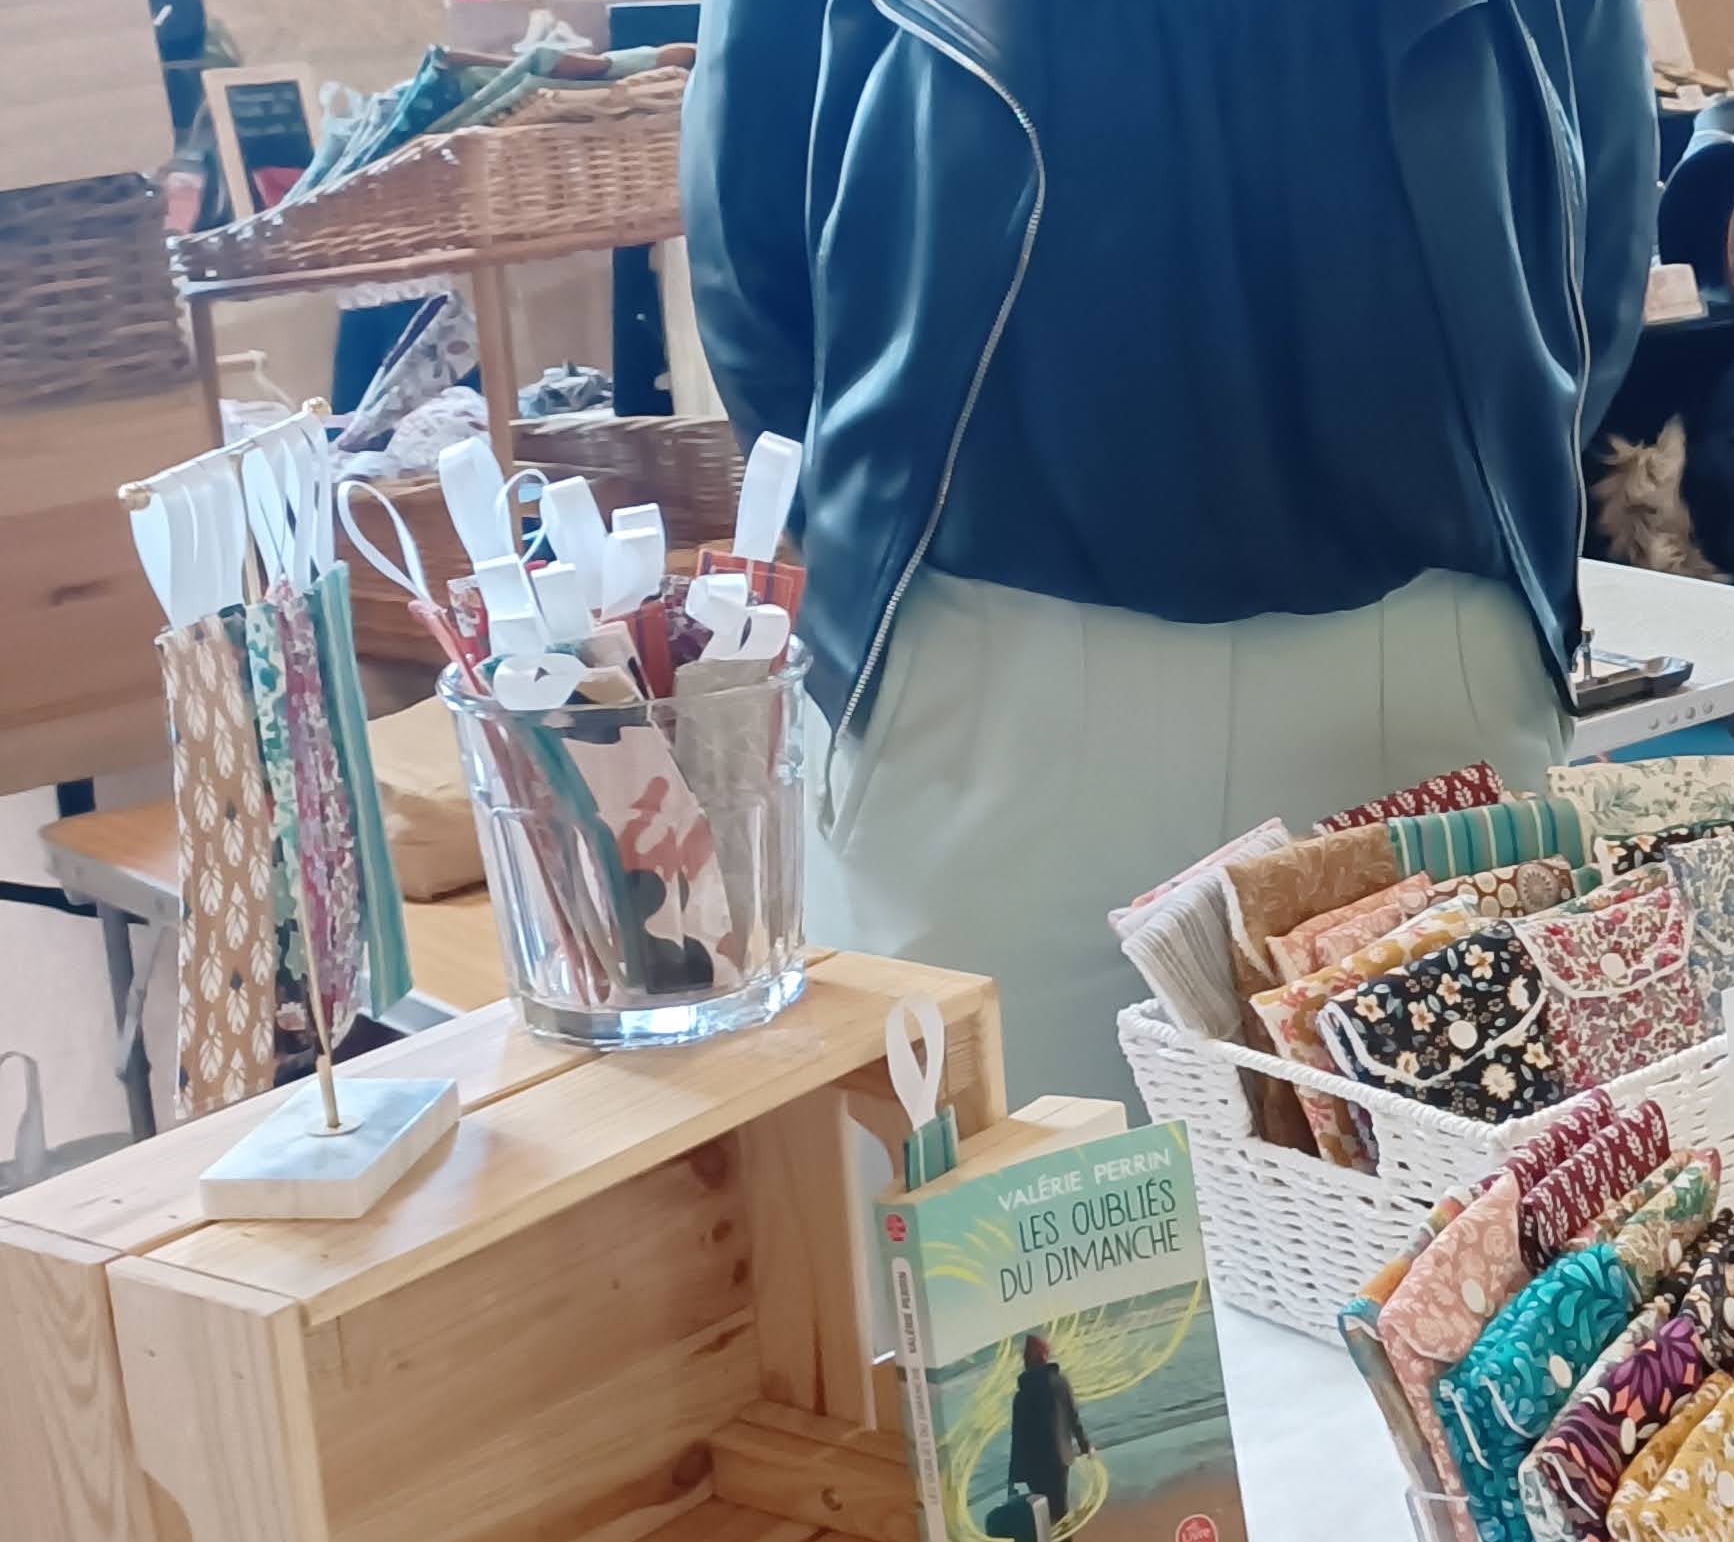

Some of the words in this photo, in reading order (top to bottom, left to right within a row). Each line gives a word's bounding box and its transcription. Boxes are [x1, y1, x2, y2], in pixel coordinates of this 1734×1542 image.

[998, 1170, 1084, 1212] VALÉRIE
[1093, 1148, 1173, 1185] PERRIN
[1018, 1210, 1060, 1253] LES
[1072, 1178, 1176, 1236] OUBLIÉS
[1000, 1261, 1033, 1303] DU
[1045, 1218, 1181, 1287] DIMANCHE
